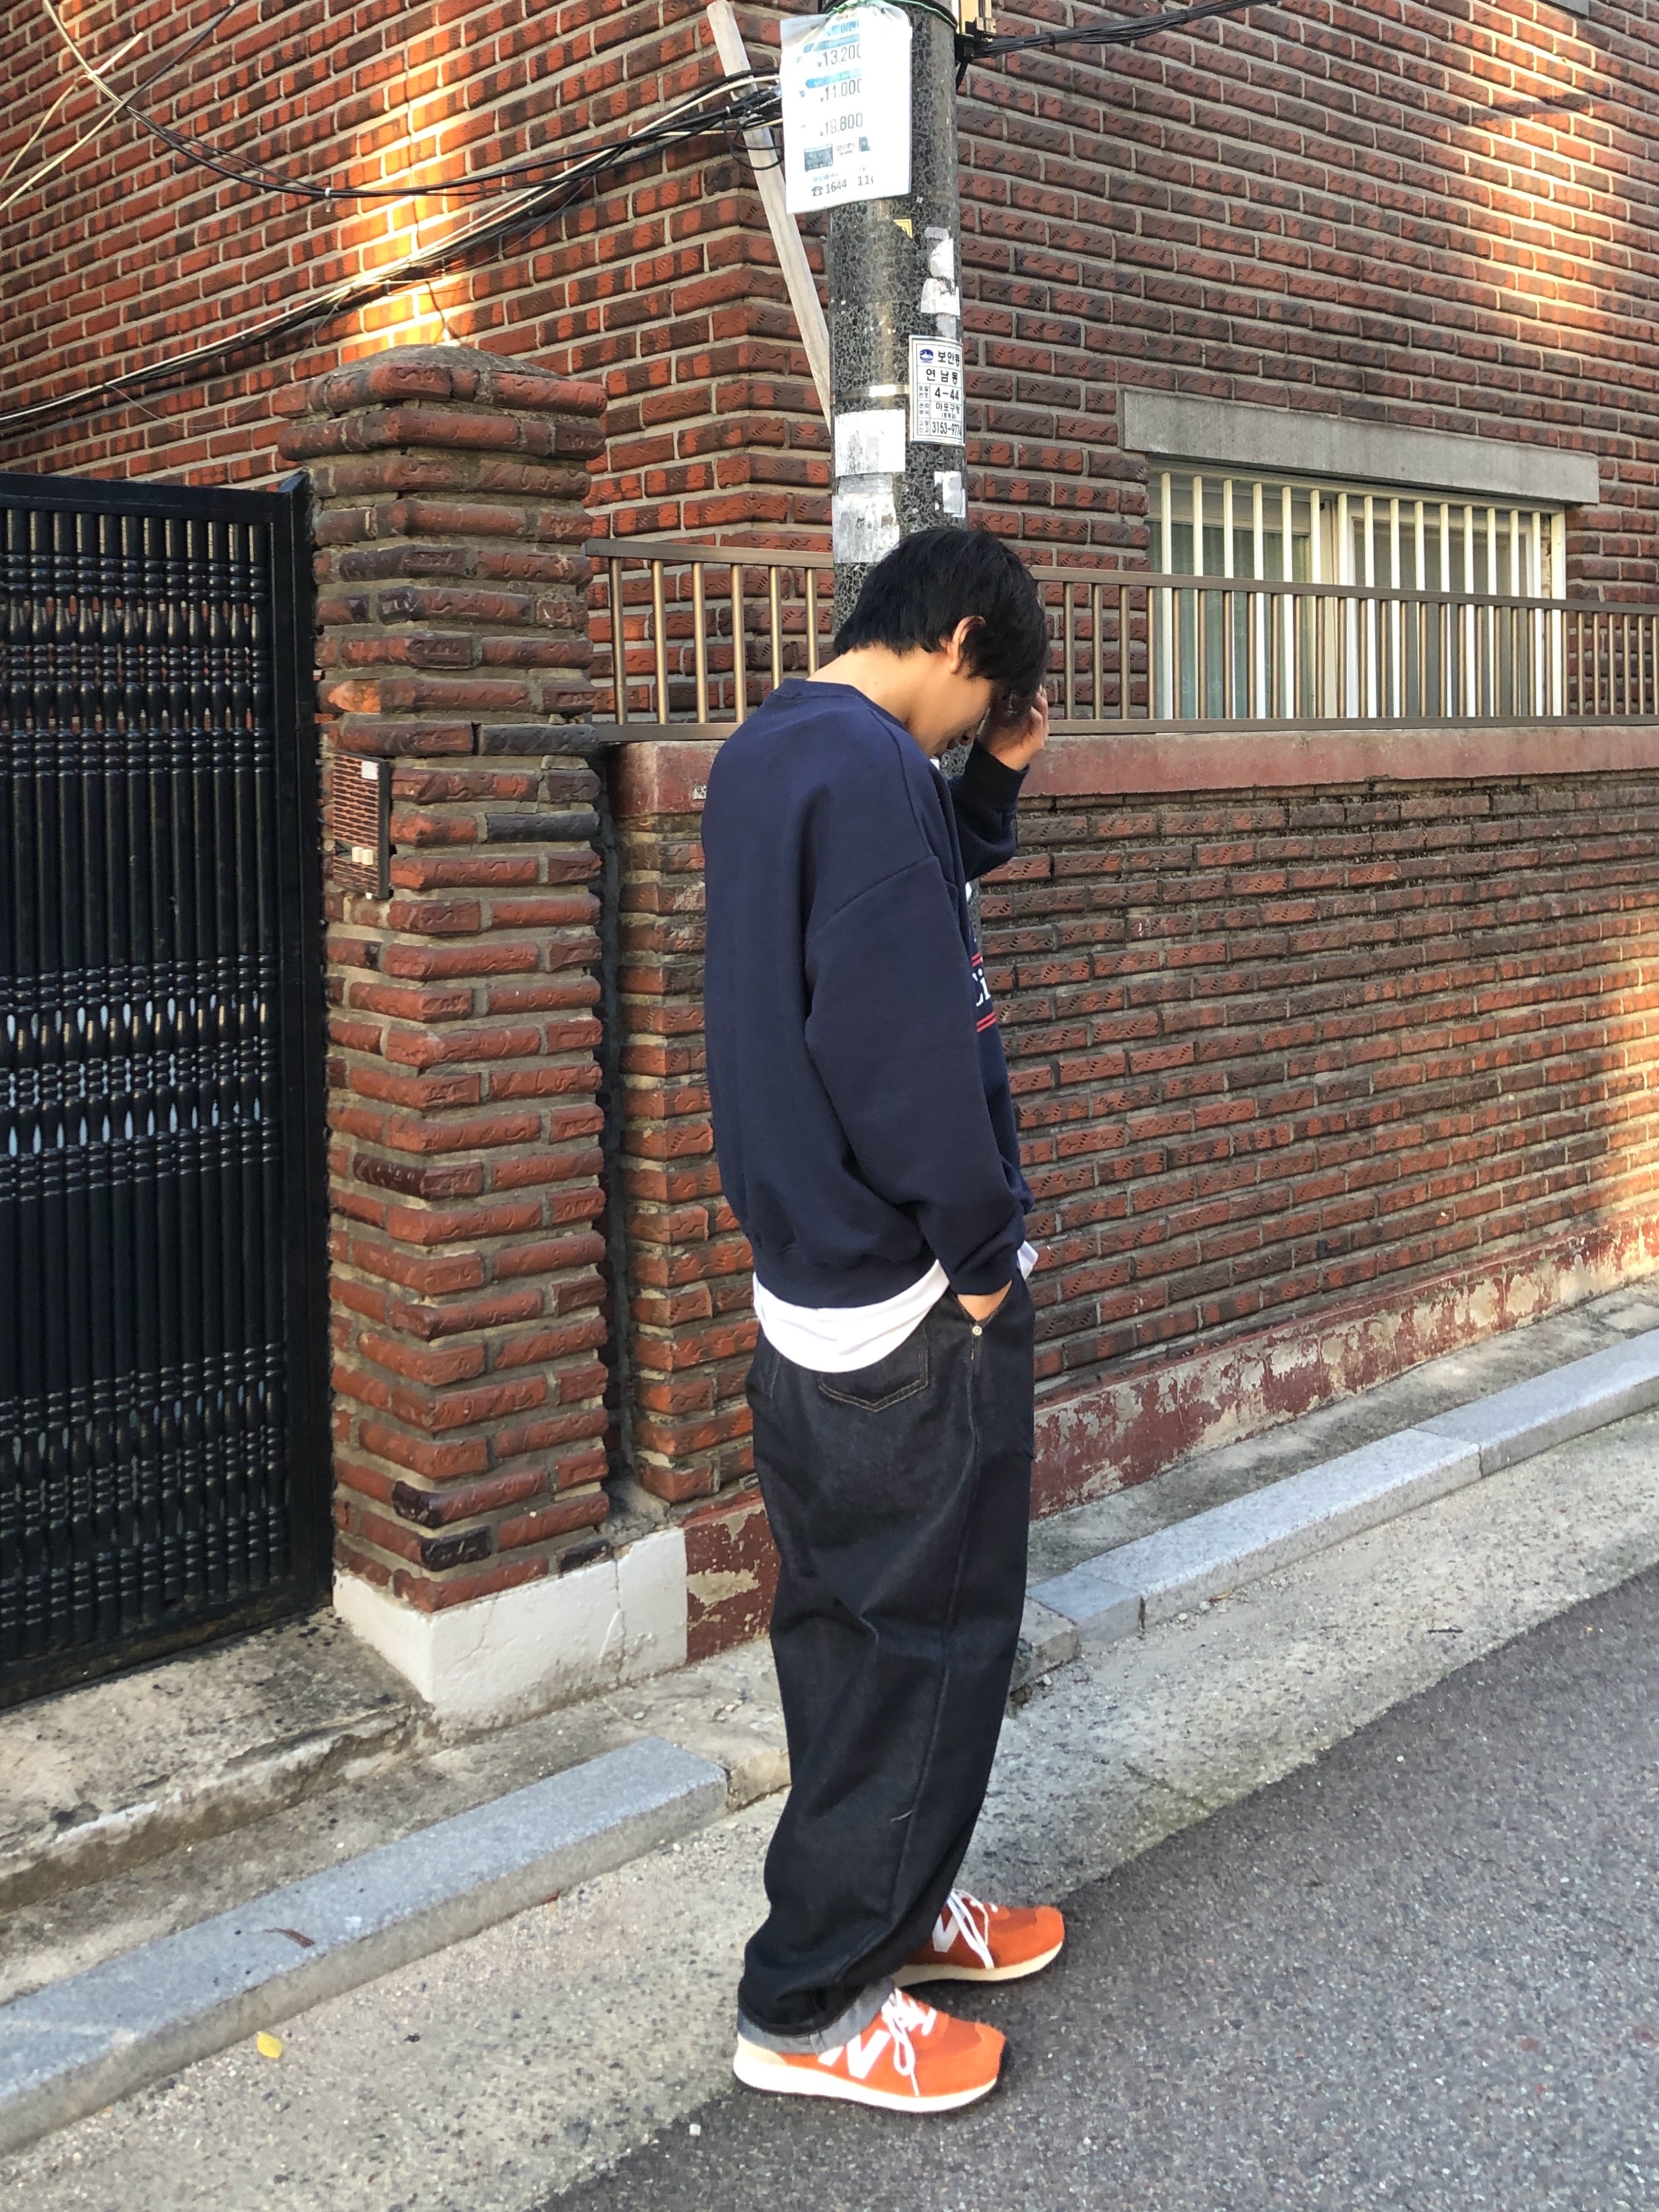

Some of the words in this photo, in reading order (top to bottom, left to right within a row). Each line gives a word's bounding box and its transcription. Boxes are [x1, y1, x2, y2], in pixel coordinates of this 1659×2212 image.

[826, 179, 847, 193] 1644
[938, 351, 960, 367] 보안등
[935, 387, 959, 401] 4-44
[936, 402, 960, 414] 마포구청
